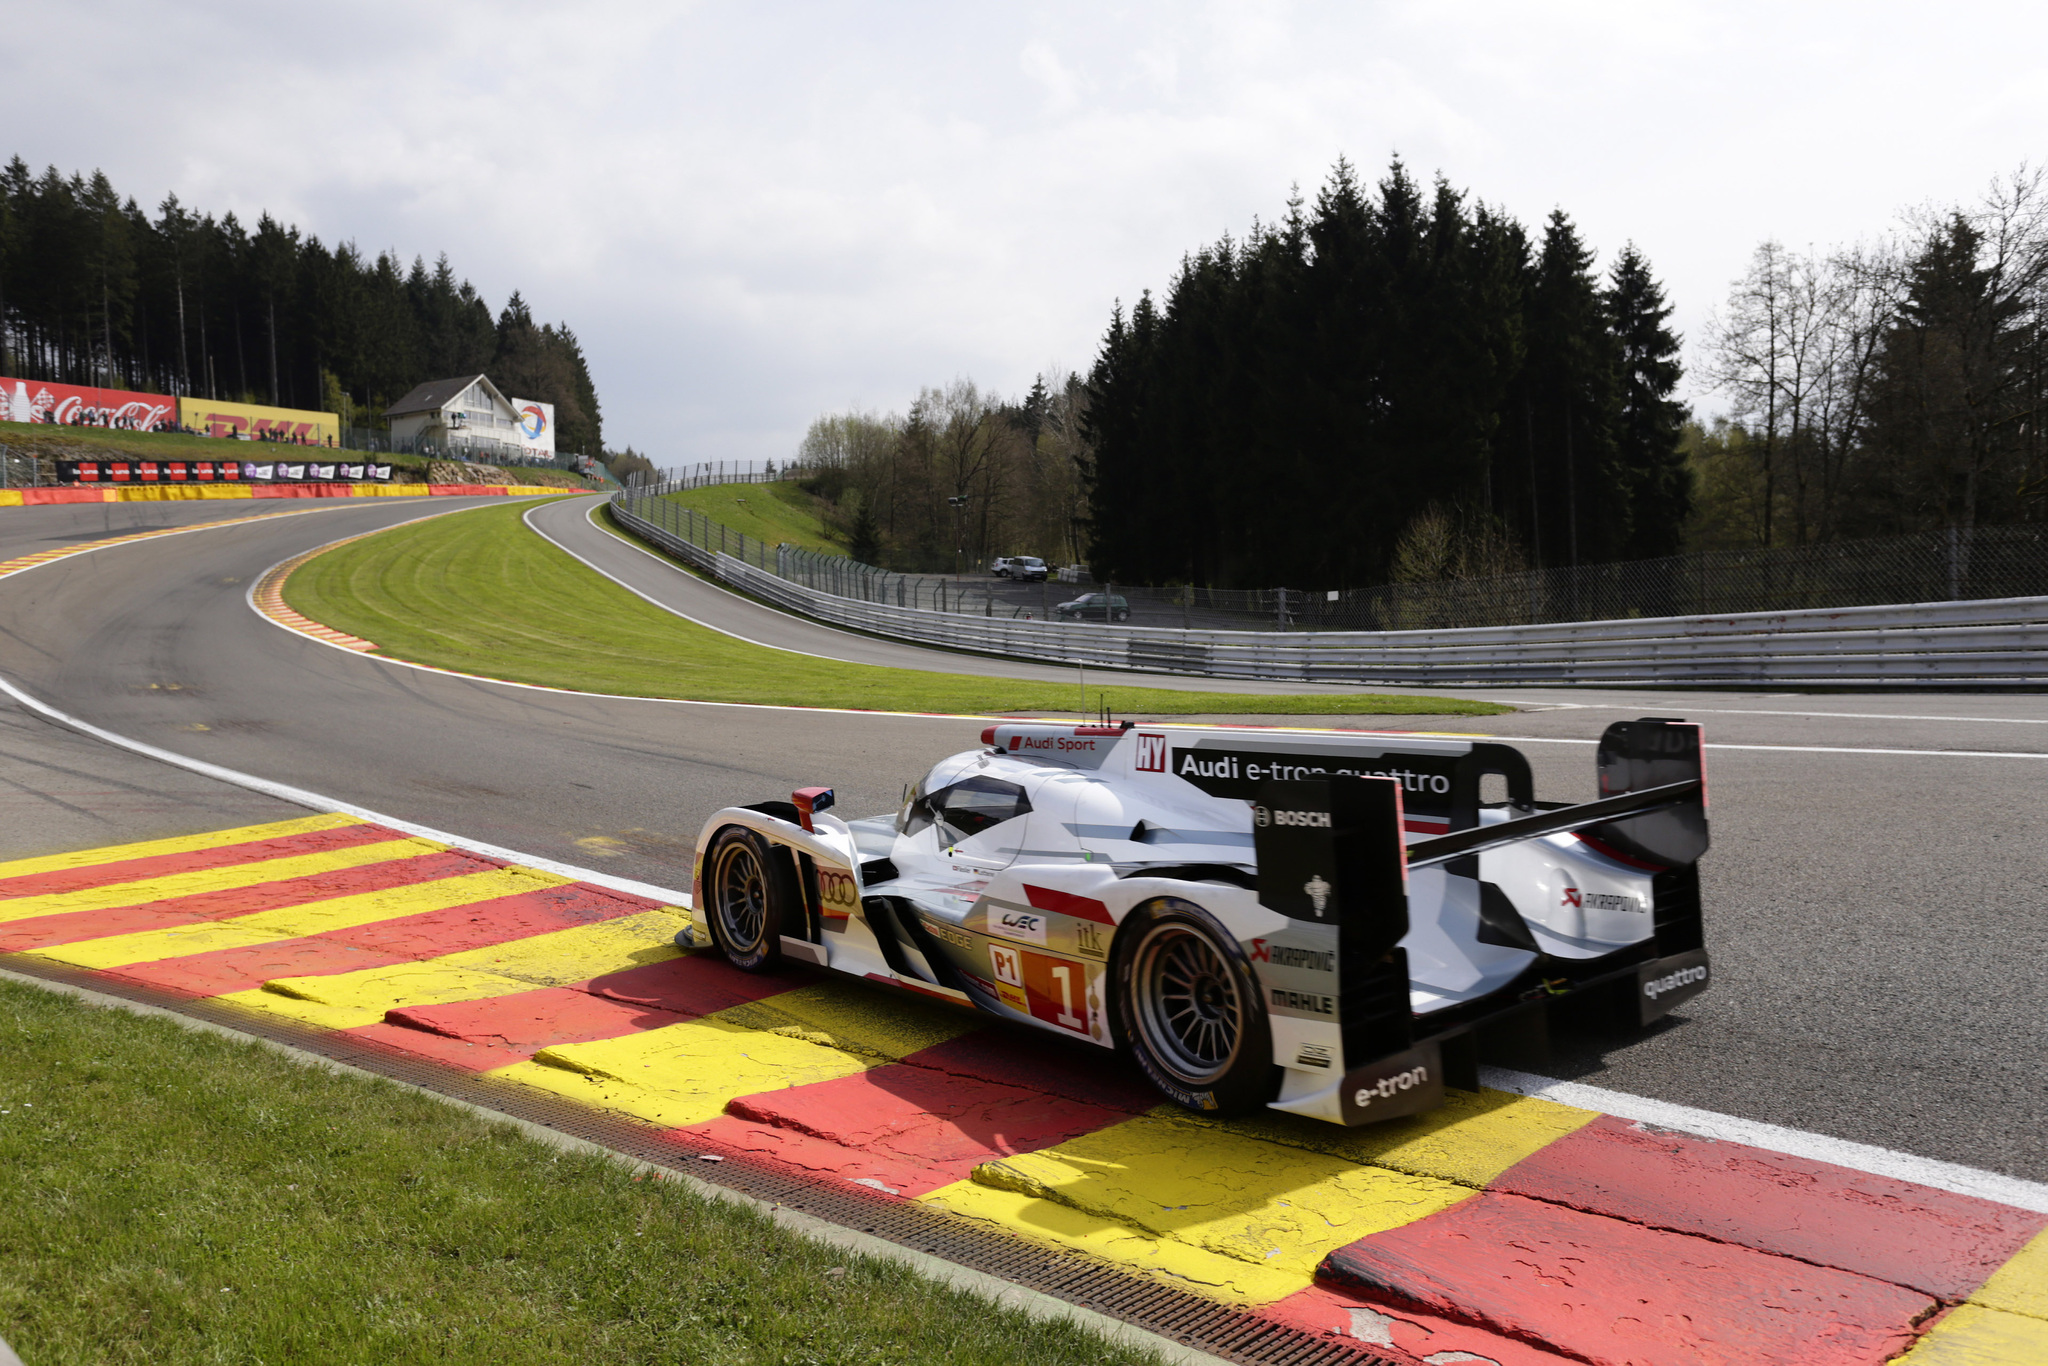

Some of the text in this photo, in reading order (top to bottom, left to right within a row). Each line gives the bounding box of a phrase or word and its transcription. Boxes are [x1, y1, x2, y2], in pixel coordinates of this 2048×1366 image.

[205, 413, 320, 445] DHL
[1024, 737, 1096, 752] Audi Sport
[1137, 734, 1166, 771] HY
[1180, 754, 1239, 779] Audi
[1337, 768, 1450, 794] ttro
[1273, 810, 1332, 828] BOSCH
[1001, 913, 1040, 932] WEC
[940, 928, 973, 950] EDGE
[994, 950, 1017, 981] P1
[1052, 966, 1083, 1030] 1
[1643, 965, 1707, 1000] quattro
[1271, 988, 1334, 1015] MAHLE
[1354, 1066, 1428, 1108] e-tron
